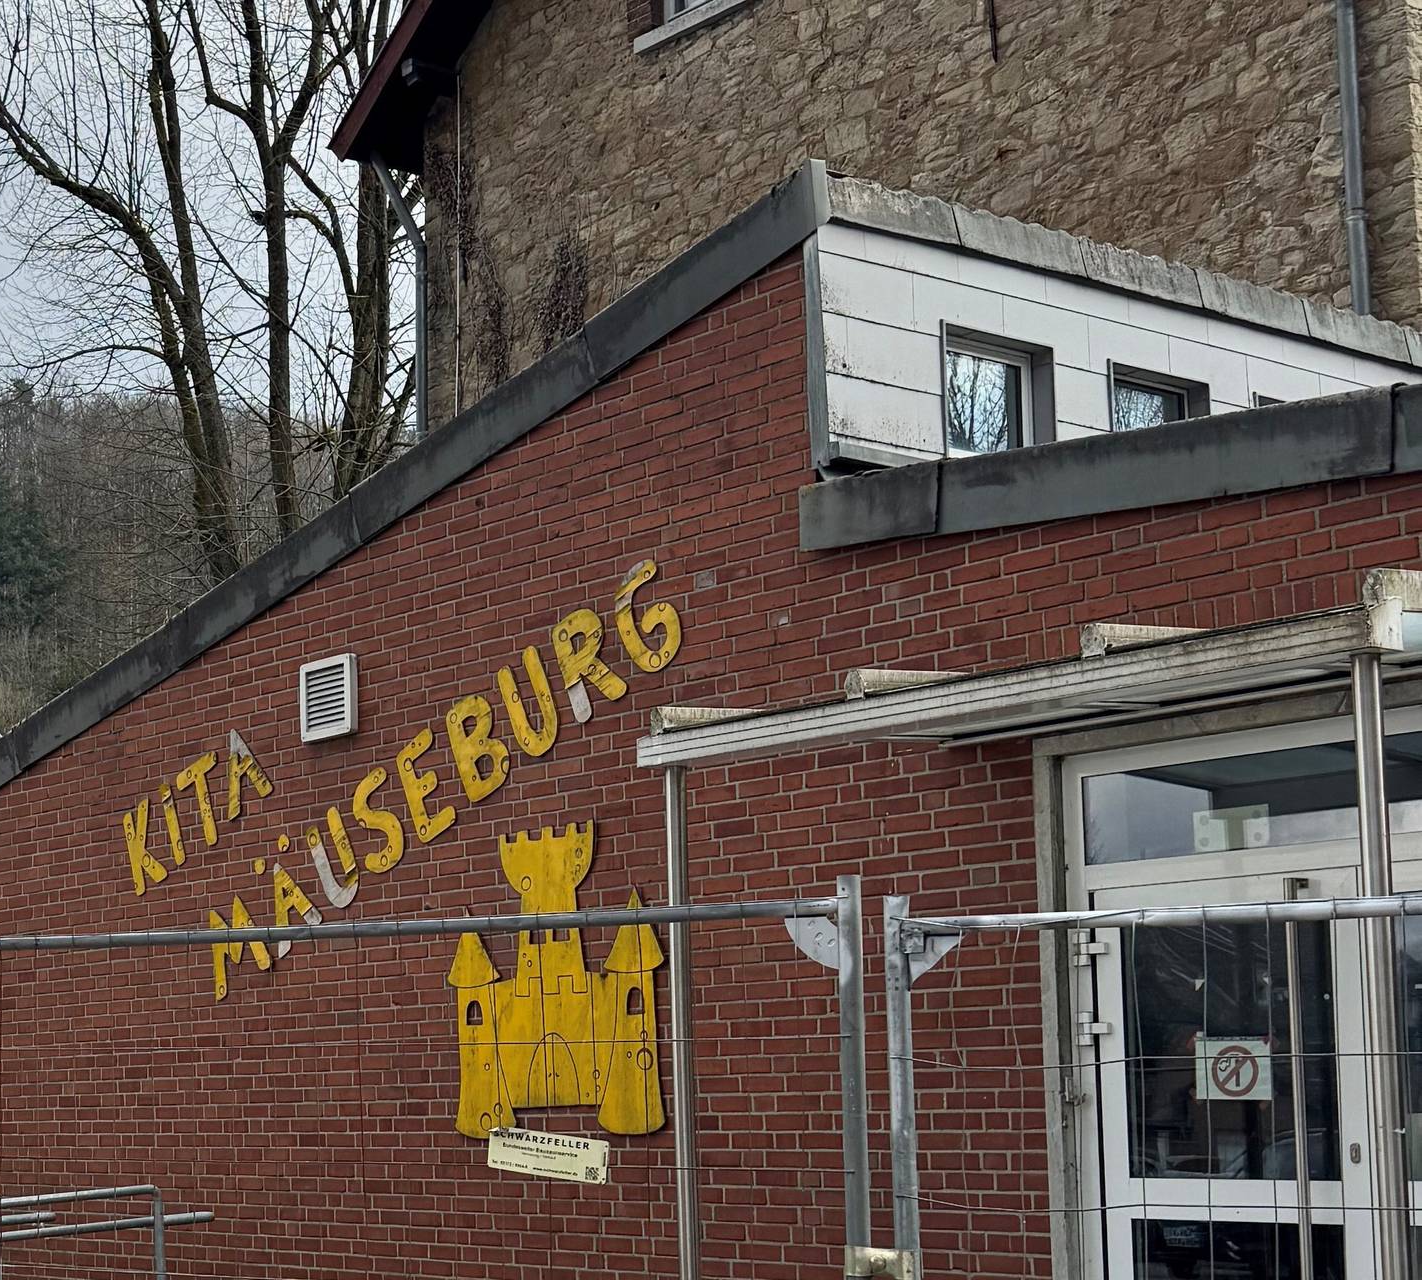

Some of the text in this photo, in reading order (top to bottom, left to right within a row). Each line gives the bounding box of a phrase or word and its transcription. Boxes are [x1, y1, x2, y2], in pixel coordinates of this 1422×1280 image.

[122, 729, 274, 896] KITA
[208, 559, 682, 1002] MÄUSEBURG
[493, 1130, 590, 1151] SCHWARZFELLER
